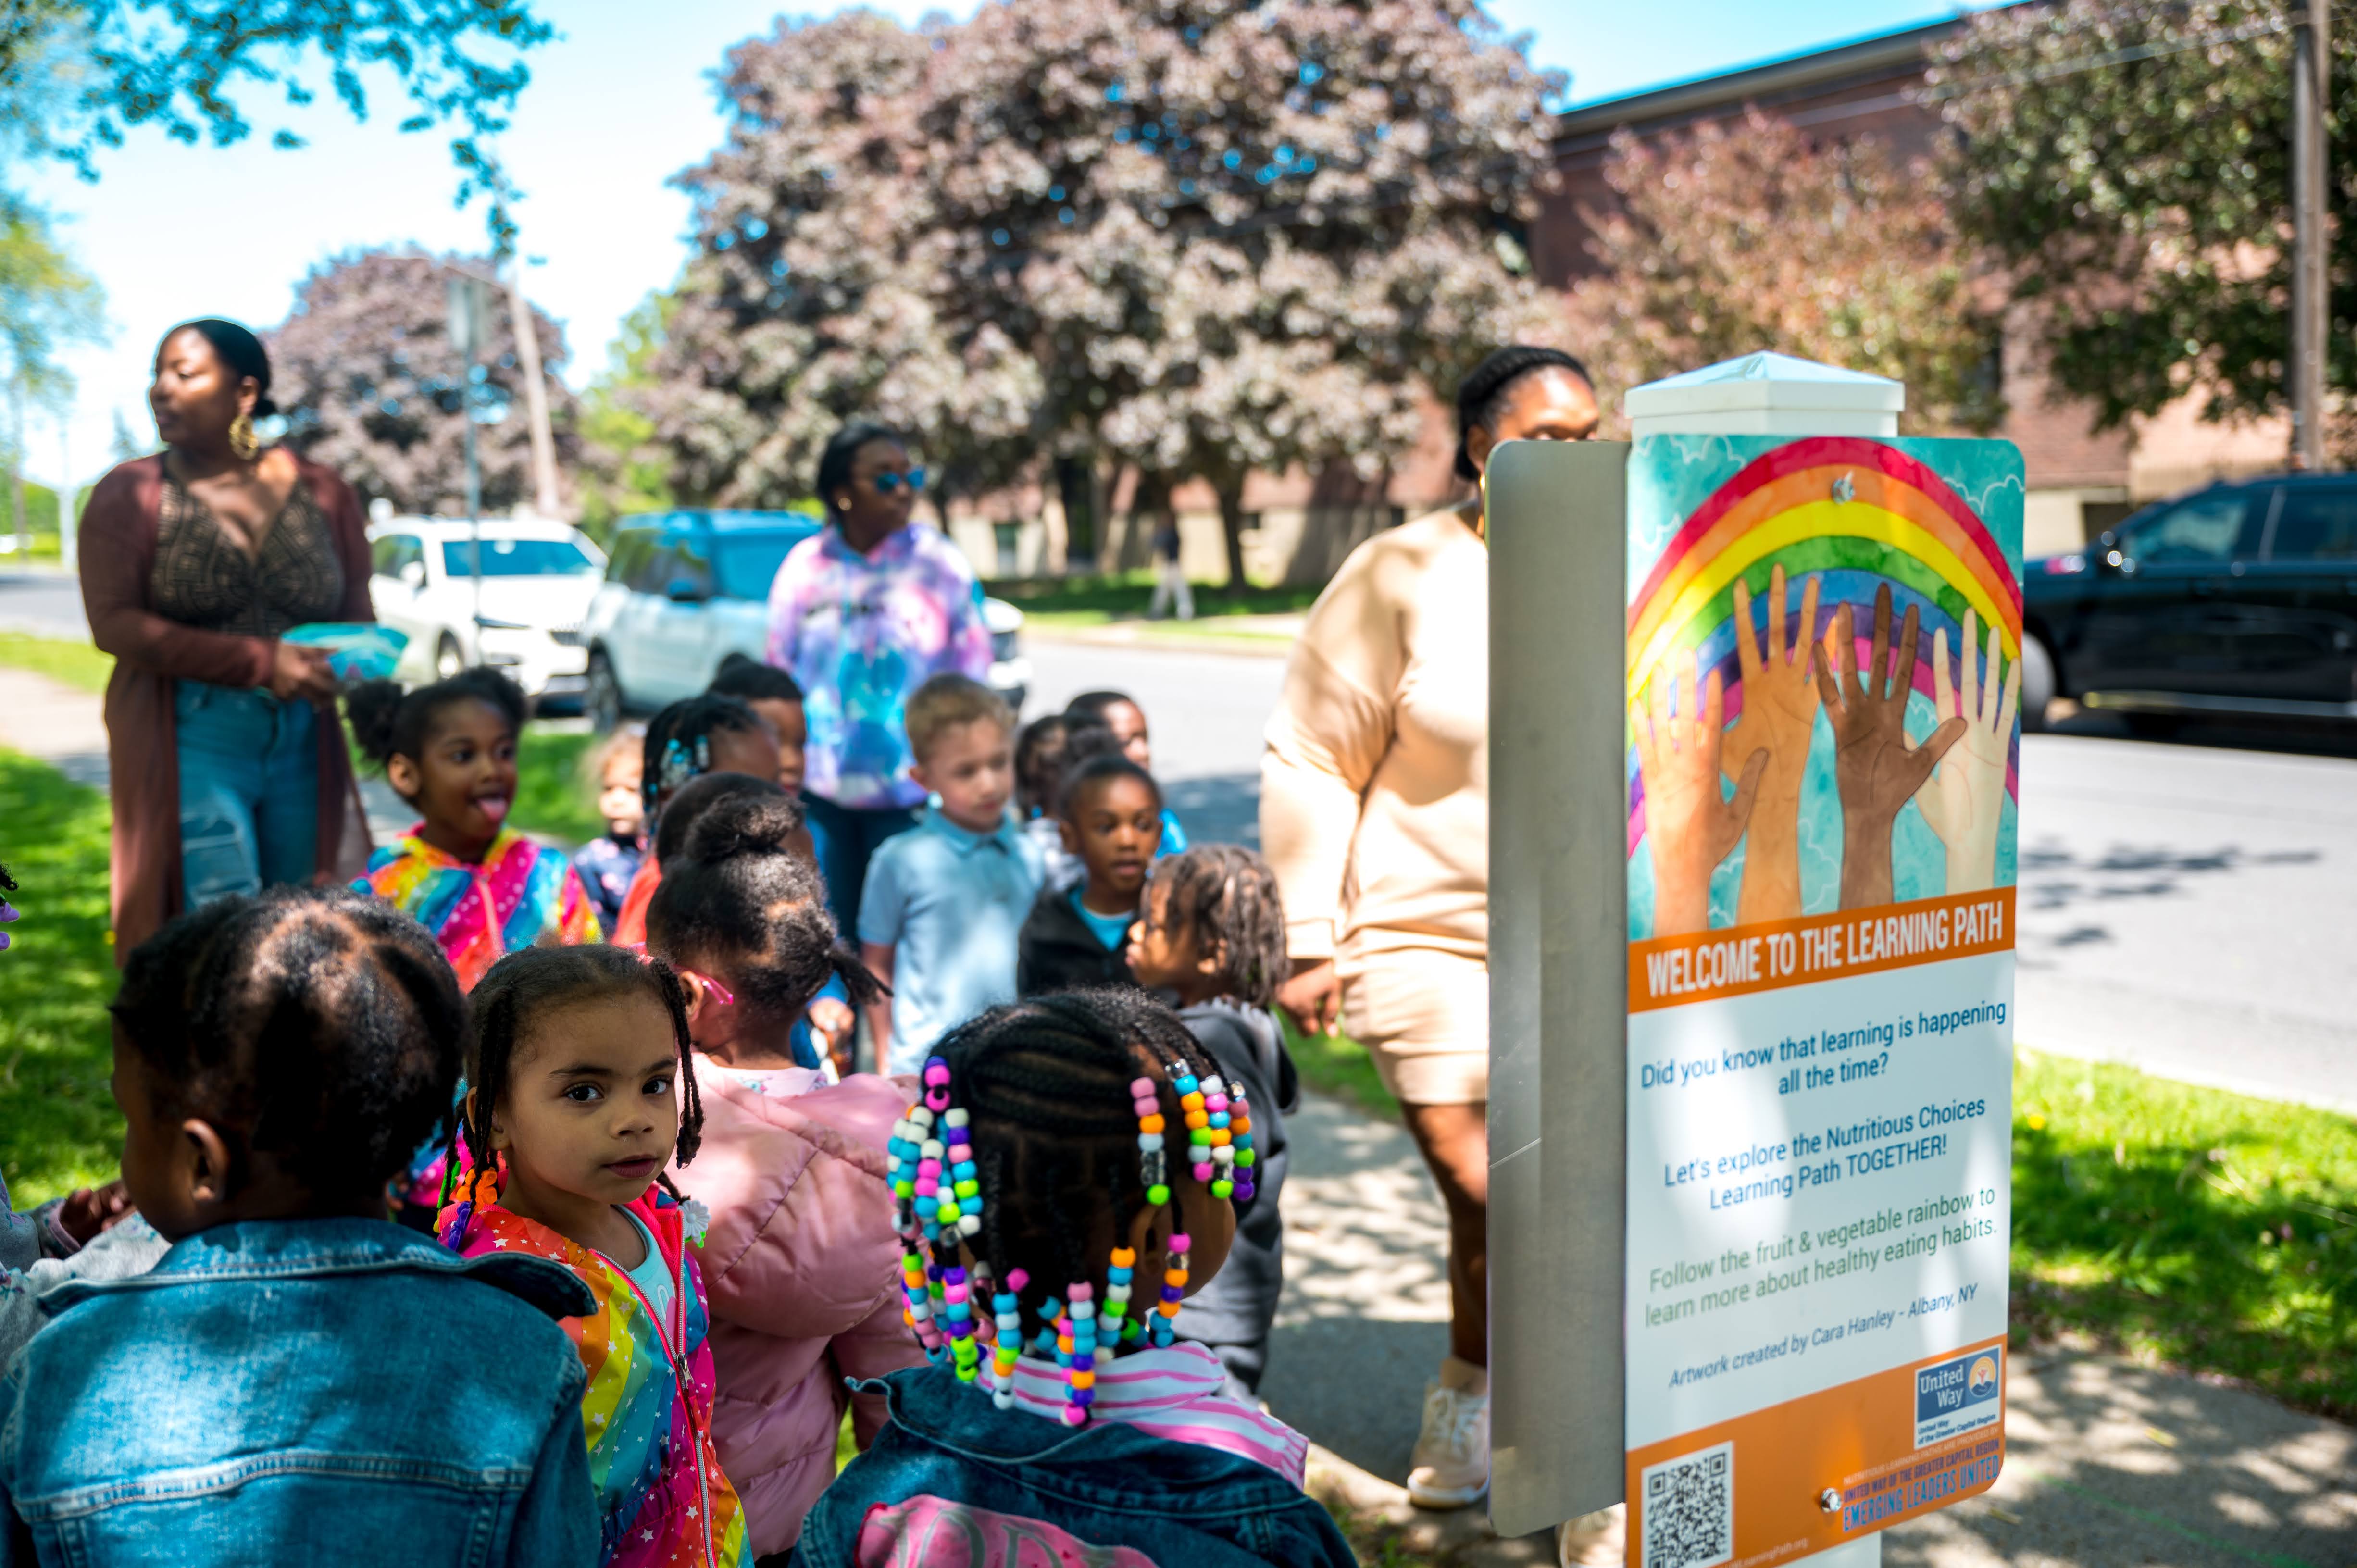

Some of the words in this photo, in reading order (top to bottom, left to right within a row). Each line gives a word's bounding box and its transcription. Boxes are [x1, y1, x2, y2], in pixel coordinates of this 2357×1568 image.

[1646, 936, 1762, 998] WELCOME
[1766, 932, 1796, 977] TO
[1800, 925, 1843, 972] THE
[1847, 908, 1949, 964] LEARNING
[1954, 900, 2003, 947] PATH
[1641, 1059, 1675, 1089] Did
[1681, 1058, 1716, 1087] you
[1723, 1046, 1774, 1072] know
[1779, 1035, 1816, 1061] that
[1822, 1021, 1894, 1053] learning
[1899, 1015, 1913, 1038] is
[1918, 1000, 2006, 1036] happening
[1779, 1068, 1800, 1095] all
[1806, 1065, 1834, 1089] the
[1840, 1052, 1889, 1082] time?
[1665, 1158, 1710, 1187] Let's
[1718, 1143, 1787, 1174] explore
[1793, 1132, 1821, 1157] the
[1826, 1115, 1914, 1149] Nutritious
[1919, 1098, 1985, 1129] Choices
[1711, 1173, 1793, 1210] Learning
[1799, 1158, 1841, 1189] Path
[1846, 1134, 1947, 1176] TOGETHER!
[1645, 1299, 1695, 1328] learn
[1700, 1283, 1750, 1313] more
[1756, 1266, 1808, 1297] about
[1814, 1248, 1880, 1281] healthy
[1884, 1232, 1937, 1262] eating
[1942, 1218, 1997, 1246] habits.
[1650, 1260, 1714, 1293] Follow
[1721, 1248, 1750, 1273] the
[1756, 1234, 1793, 1264] fruit
[1799, 1231, 1811, 1253] &
[1817, 1207, 1902, 1248] vegetable
[1907, 1194, 1974, 1225] rainbow
[1980, 1188, 1995, 1206] to
[1669, 1355, 1729, 1388] Artwork
[1732, 1336, 1788, 1370] created
[1791, 1333, 1808, 1355] by
[1812, 1325, 1845, 1346] Cara
[1848, 1309, 1895, 1335] Hanley
[1908, 1294, 1955, 1319] Albany,
[1958, 1282, 1978, 1303] NY
[1920, 1364, 1964, 1394] United
[1937, 1388, 1964, 1408] Way
[1918, 1422, 1935, 1434] United
[1918, 1437, 1924, 1445] of
[1924, 1434, 1934, 1443] the
[1935, 1428, 1956, 1440] Greater
[1957, 1420, 1976, 1433] Capital
[1977, 1414, 1995, 1427] Region
[1937, 1419, 1950, 1429] Way
[1844, 1483, 1869, 1503] UNITED
[1871, 1477, 1886, 1493] WAY
[1889, 1473, 1897, 1488] OF
[1899, 1467, 1913, 1483] THE
[1914, 1455, 1945, 1477] GREATER
[1946, 1447, 1973, 1468] CAPITAL
[1976, 1438, 1999, 1456] REGION
[1844, 1488, 1903, 1532] EMERGING
[1907, 1468, 1956, 1508] LEADERS
[1960, 1455, 1999, 1489] UNITED
